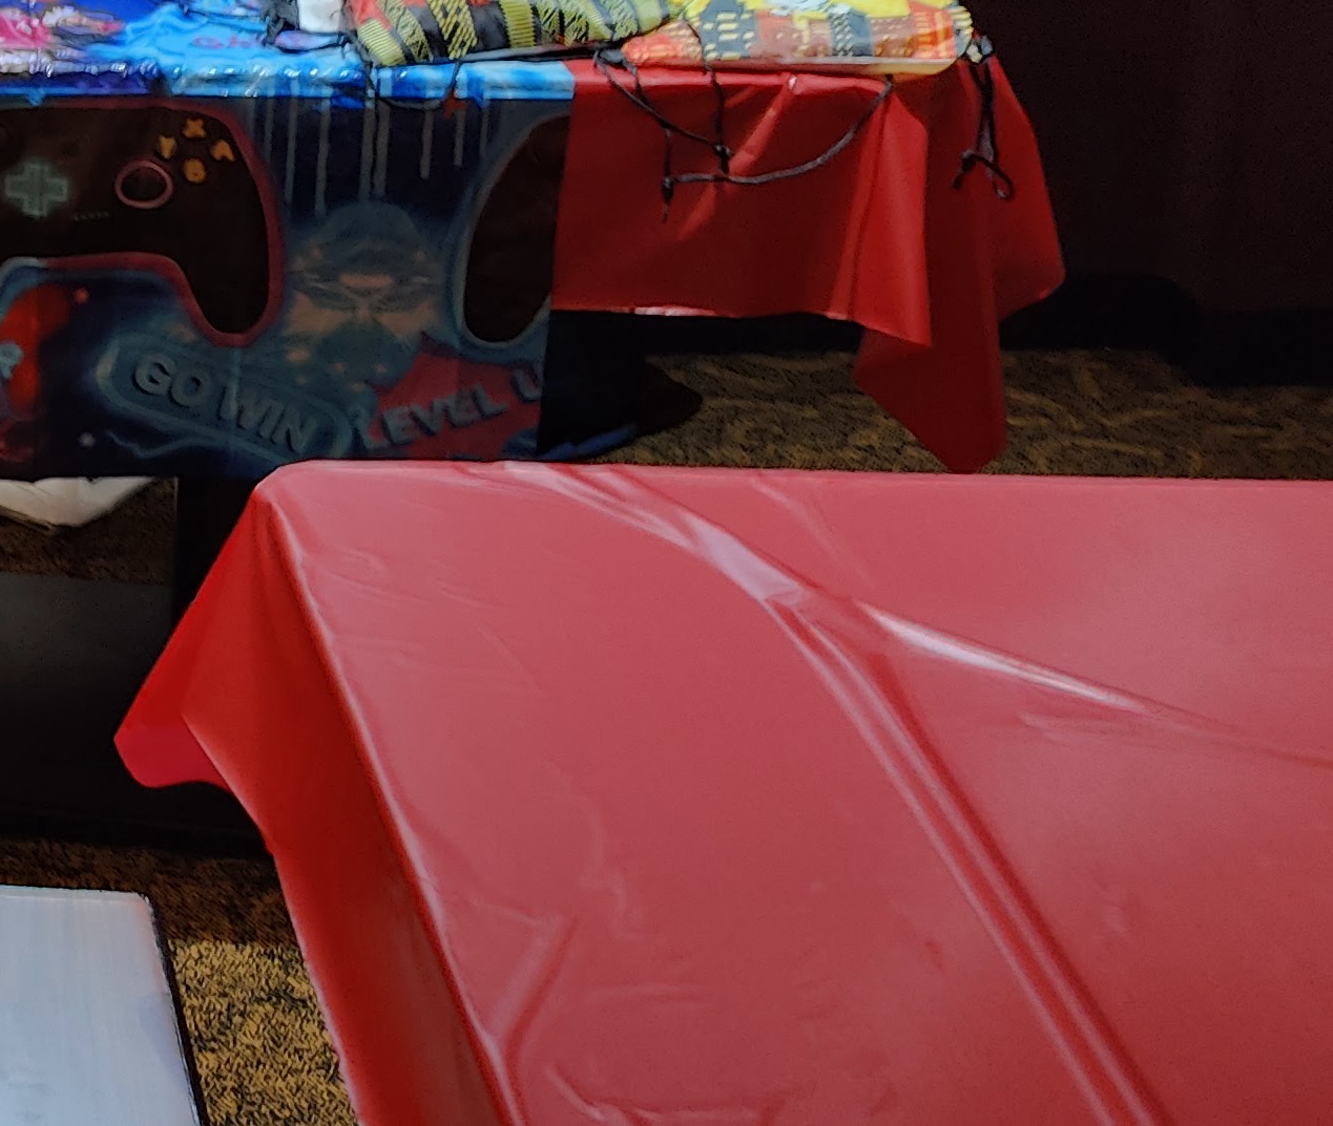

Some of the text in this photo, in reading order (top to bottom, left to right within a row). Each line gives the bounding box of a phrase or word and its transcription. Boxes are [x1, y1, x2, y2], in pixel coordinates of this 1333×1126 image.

[134, 352, 320, 454] GO WIN
[353, 386, 509, 450] LEVEL
